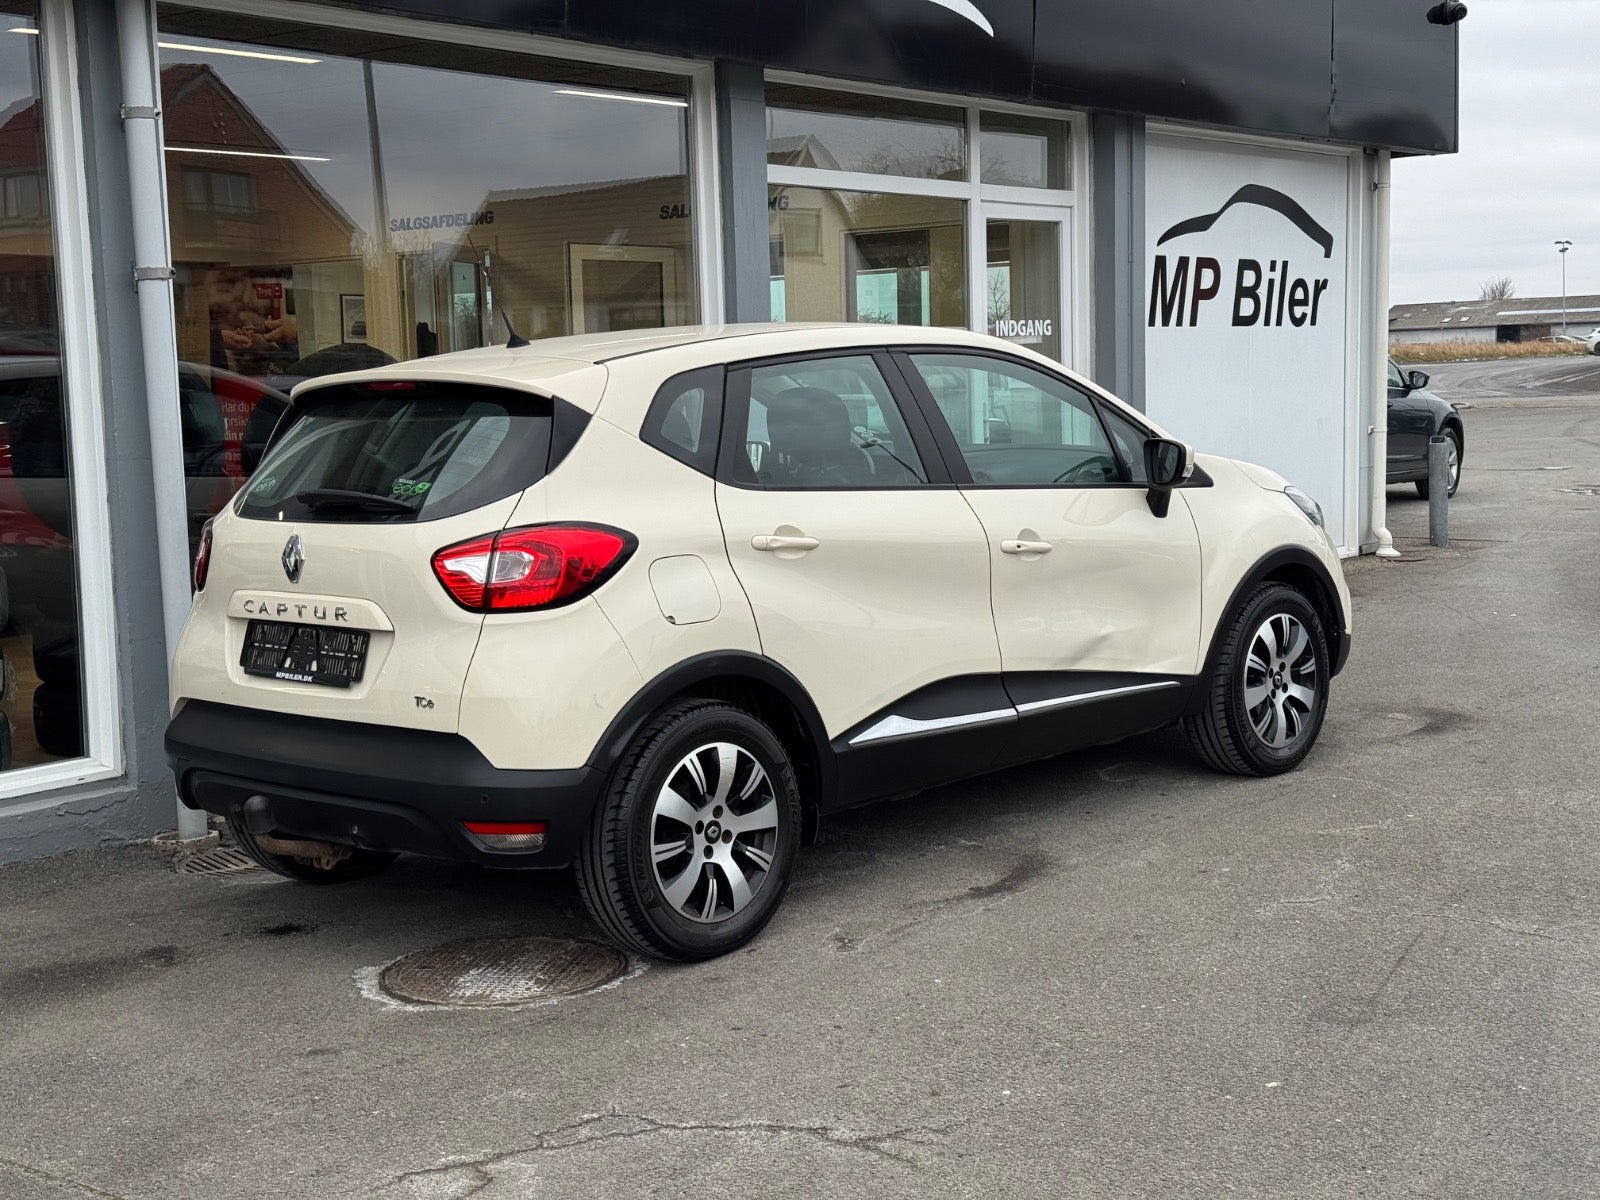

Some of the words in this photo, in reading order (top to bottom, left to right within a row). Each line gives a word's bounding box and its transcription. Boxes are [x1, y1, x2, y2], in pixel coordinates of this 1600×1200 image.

[390, 210, 494, 232] SALGSAFDELING
[1147, 254, 1221, 327] MP
[1231, 258, 1329, 328] Biler
[995, 319, 1052, 337] INDGANG
[243, 599, 349, 621] CAPTUR
[275, 671, 313, 682] MPBILER.DK
